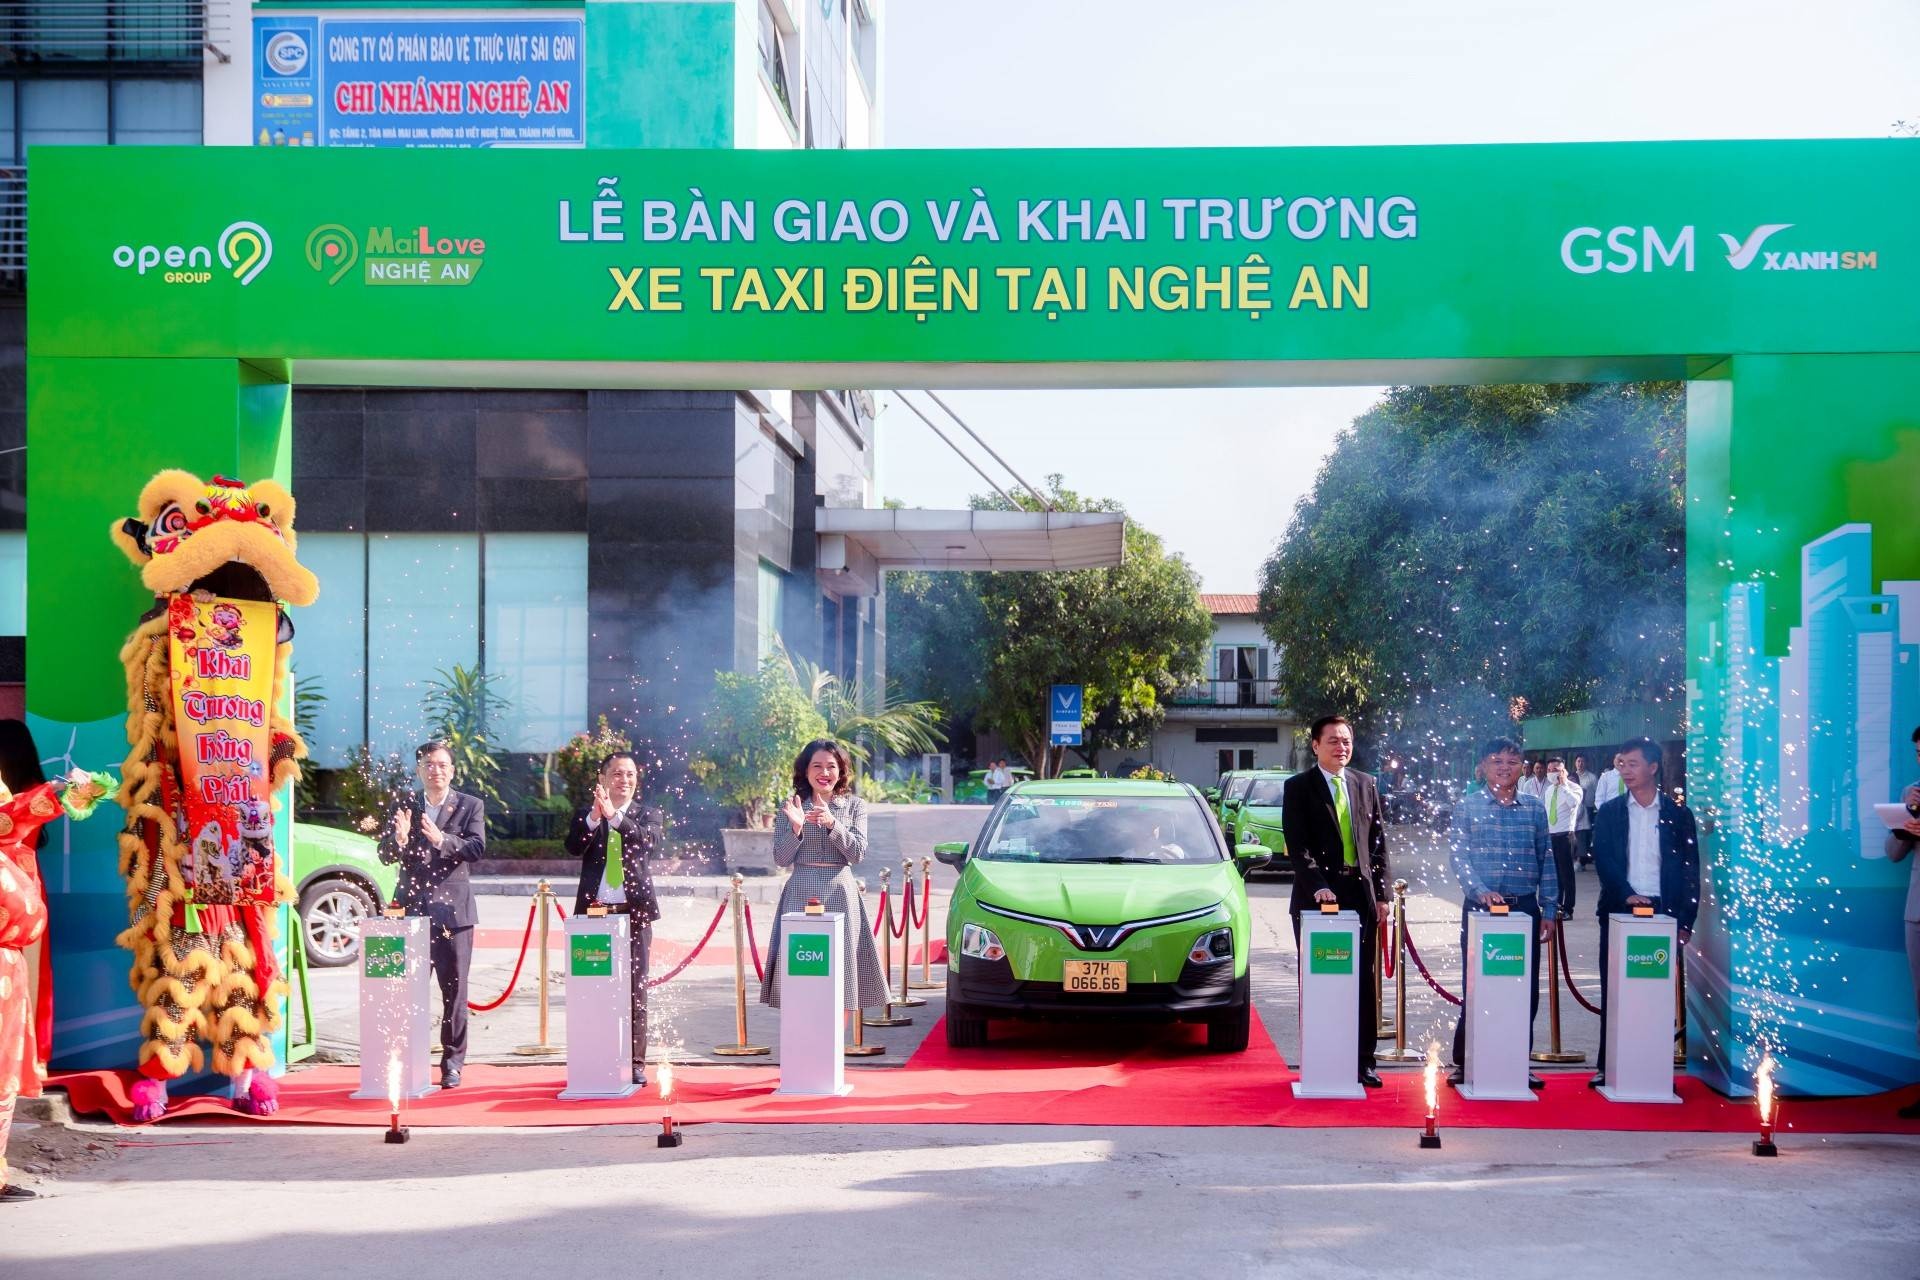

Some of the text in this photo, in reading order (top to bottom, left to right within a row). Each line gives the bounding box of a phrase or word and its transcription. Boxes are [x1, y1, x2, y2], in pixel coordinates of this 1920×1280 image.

[279, 47, 304, 59] SPC
[361, 37, 376, 62] TY
[335, 77, 570, 118] CHI NHÁNH NGHỆ AN
[559, 177, 1417, 242] LỄ BÀN GIAO VÀ KHAI TRƯƠNG
[113, 245, 212, 275] open
[1560, 225, 1695, 274] GSM
[164, 272, 212, 283] GROUP
[370, 260, 470, 283] NGHỆ AN
[608, 254, 1368, 321] XE TAXI ĐIỆN TẠI NGHỆ AN
[197, 648, 251, 680] Khai
[201, 775, 250, 805] Phát
[796, 950, 824, 961] GSM
[1627, 954, 1653, 963] open
[1082, 962, 1110, 975] 37H
[1071, 976, 1120, 990] 066.66
